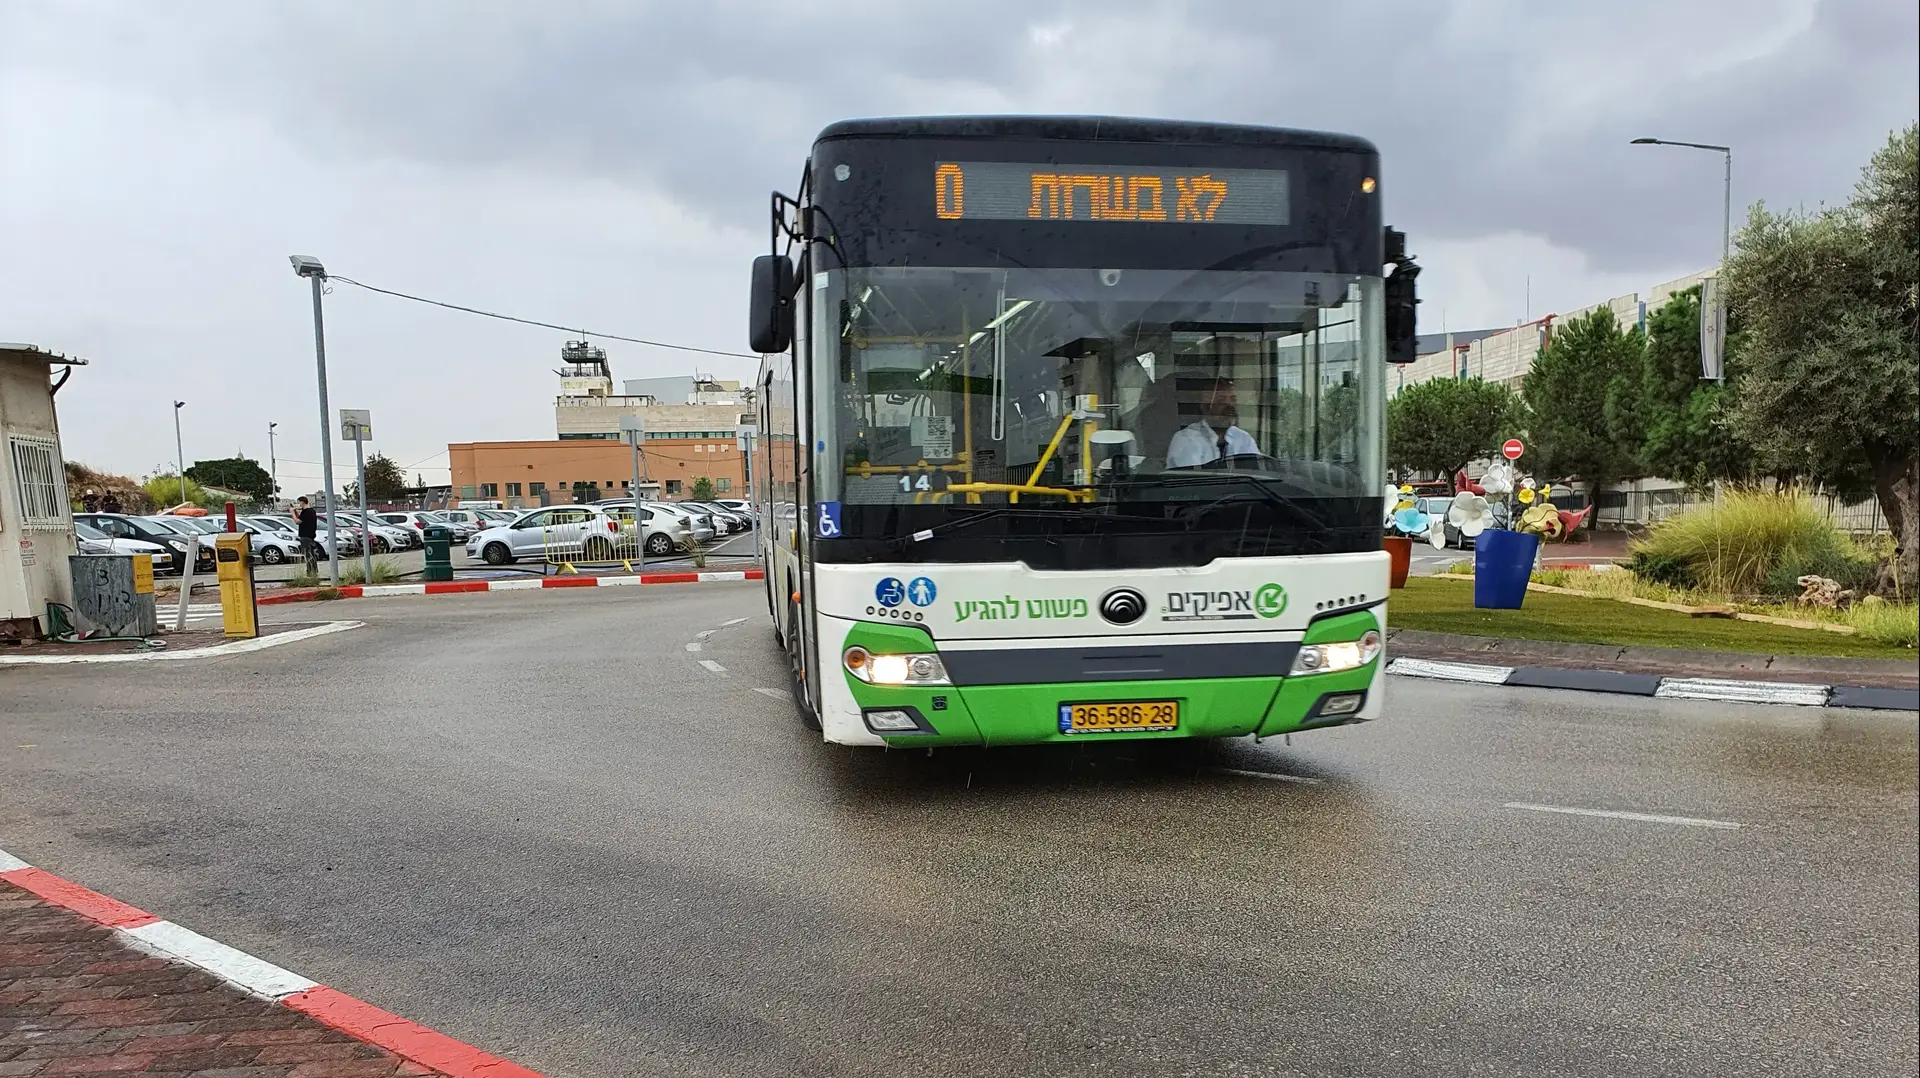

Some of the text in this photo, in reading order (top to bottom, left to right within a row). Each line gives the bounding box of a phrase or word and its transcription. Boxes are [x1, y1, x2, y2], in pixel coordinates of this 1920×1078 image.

[936, 164, 964, 219] 0
[1028, 174, 1227, 221] לא בשרות
[899, 475, 930, 492] 14
[954, 595, 1088, 622] פשוט להגיע
[1167, 591, 1252, 616] אפיקים
